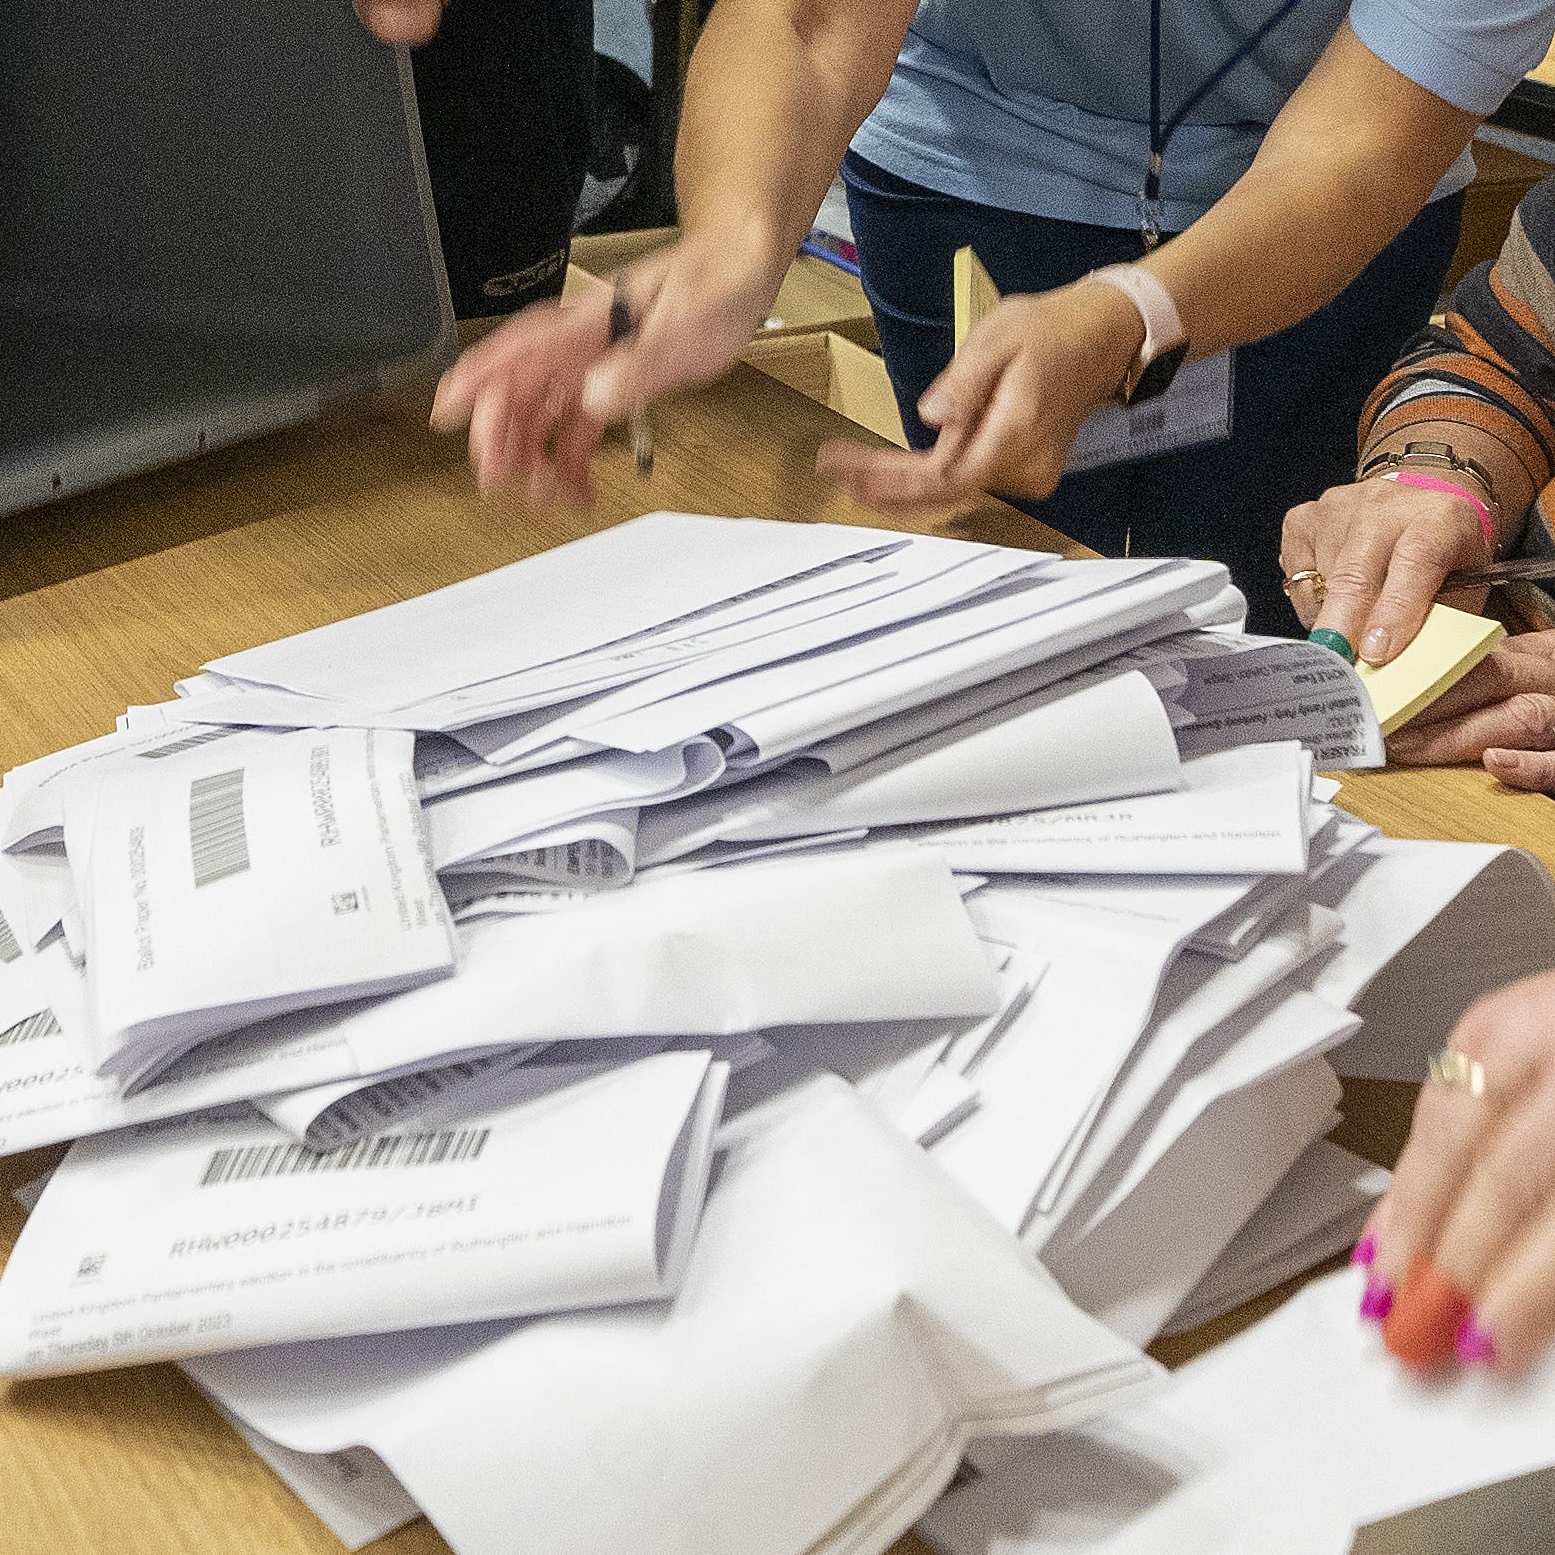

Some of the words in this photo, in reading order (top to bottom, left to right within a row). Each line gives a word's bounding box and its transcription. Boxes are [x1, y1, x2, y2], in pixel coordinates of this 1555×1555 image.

[1274, 708, 1296, 719] Party
[1297, 703, 1326, 715] Family
[1320, 745, 1367, 759] FRASER
[46, 1332, 110, 1362] Thursday
[111, 1327, 133, 1347] 5th
[136, 1316, 192, 1344] October
